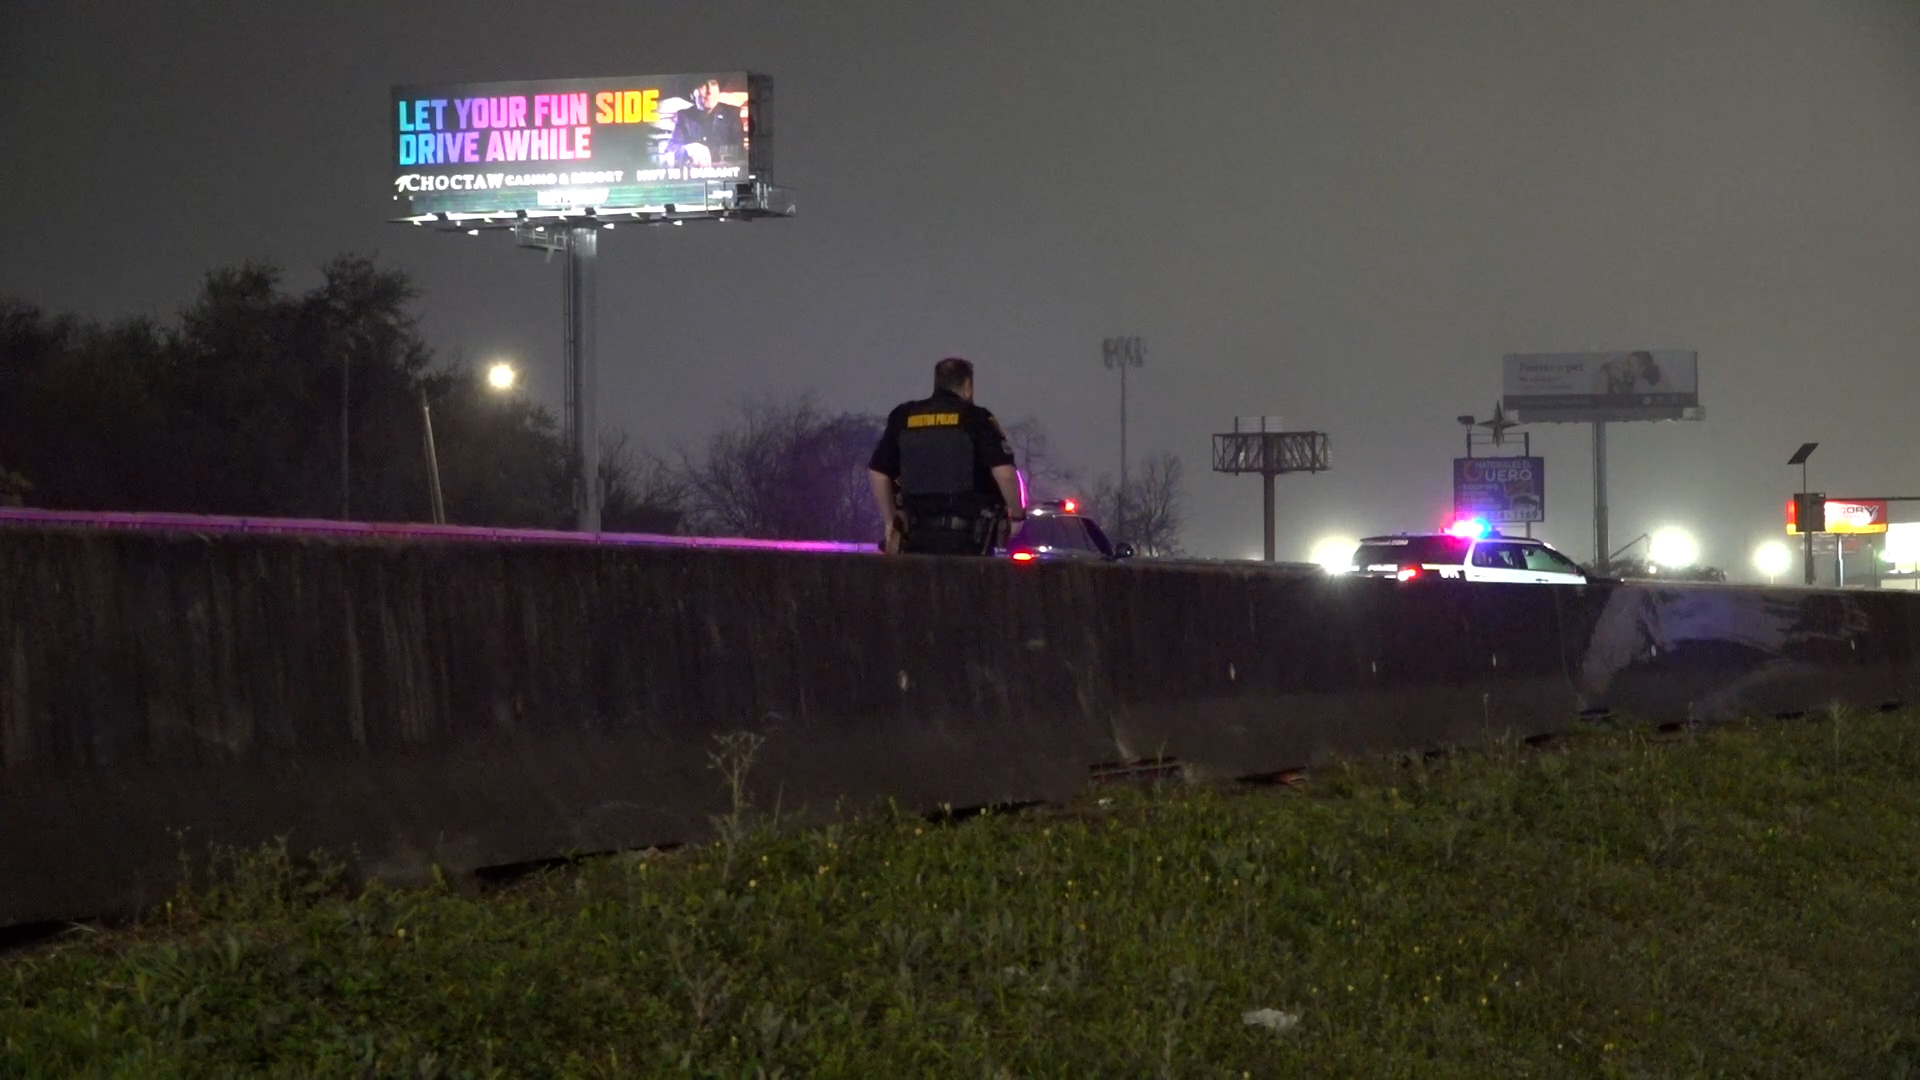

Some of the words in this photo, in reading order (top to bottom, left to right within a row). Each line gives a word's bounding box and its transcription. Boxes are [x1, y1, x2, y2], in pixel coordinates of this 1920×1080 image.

[399, 99, 448, 131] LET
[453, 95, 527, 129] YOUR
[534, 92, 589, 127] FUN
[595, 89, 660, 124] SIDE
[399, 131, 479, 165] DRIVE
[485, 127, 592, 162] AWHILE
[406, 173, 505, 191] CHOCTAW
